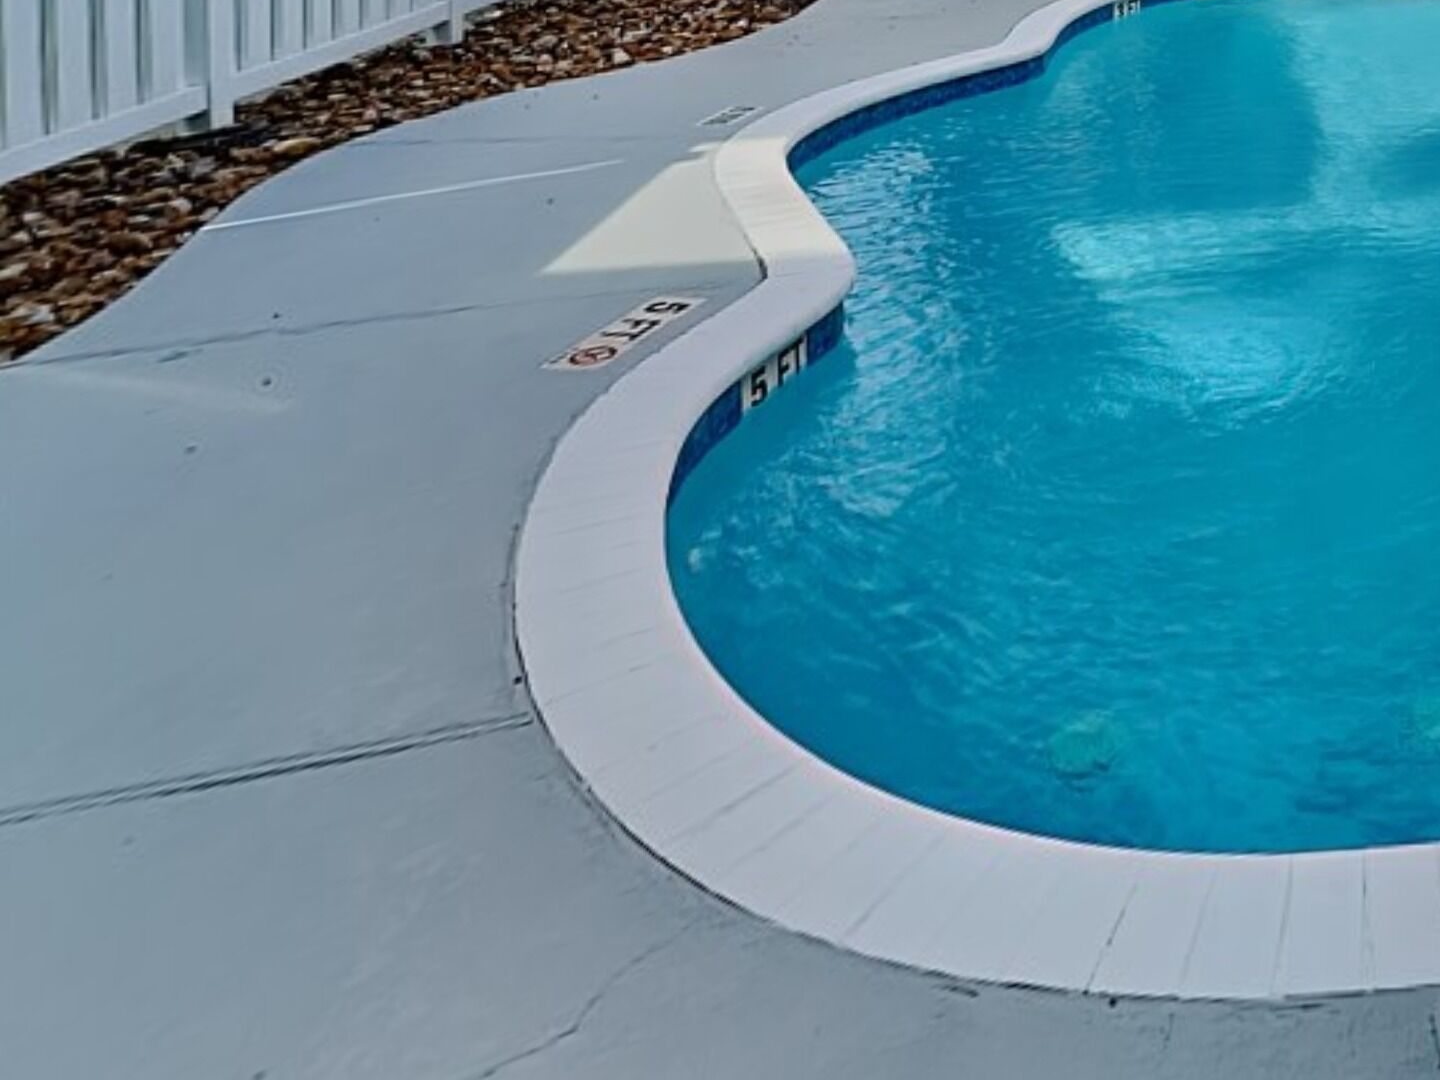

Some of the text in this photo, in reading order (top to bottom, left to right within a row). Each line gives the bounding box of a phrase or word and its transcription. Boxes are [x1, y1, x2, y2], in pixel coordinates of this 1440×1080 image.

[602, 301, 690, 341] 5 FT
[751, 335, 804, 407] 5 FT
